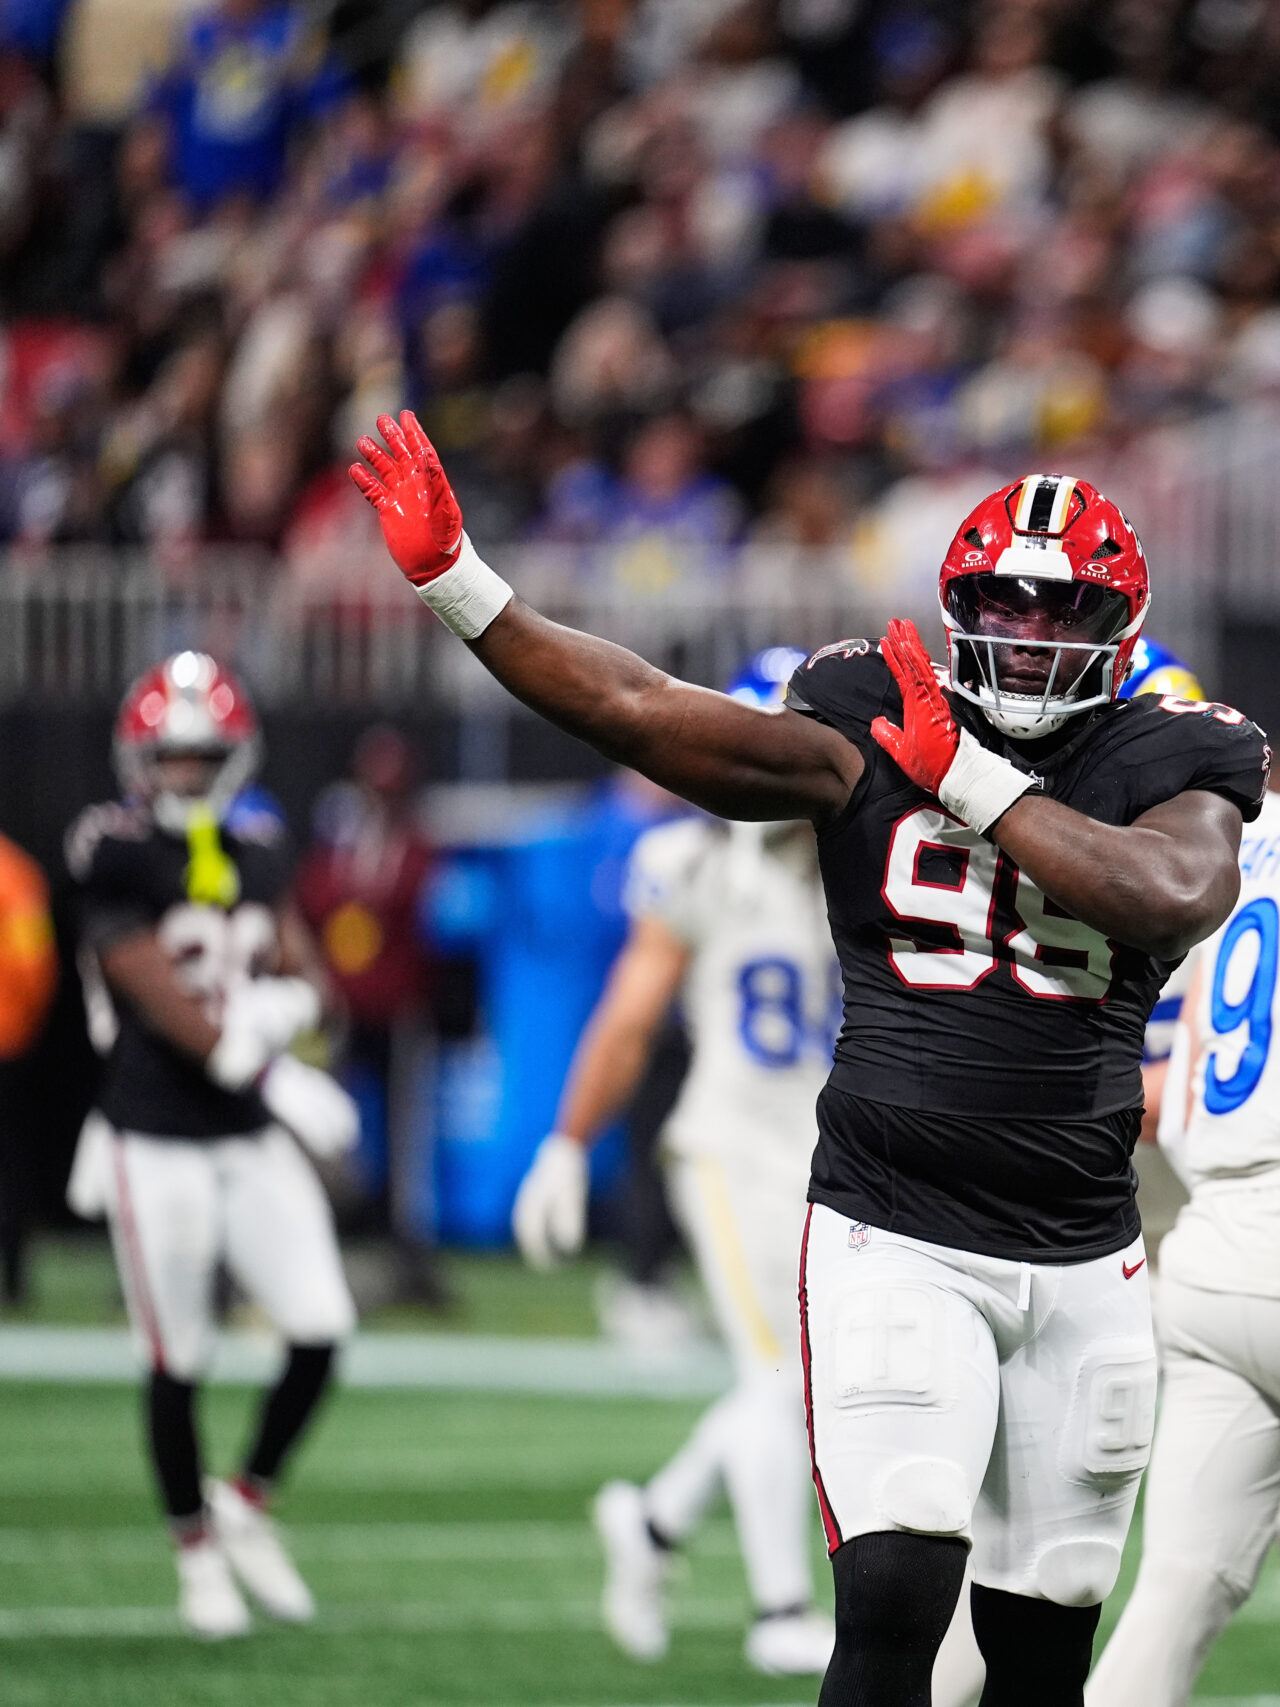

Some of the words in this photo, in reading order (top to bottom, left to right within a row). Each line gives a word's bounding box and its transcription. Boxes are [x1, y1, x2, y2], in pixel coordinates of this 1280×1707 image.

[961, 559, 989, 568] OAKLEY
[1080, 570, 1112, 580] OAKLEY
[880, 802, 1119, 1005] 98
[1203, 897, 1280, 1115] 9
